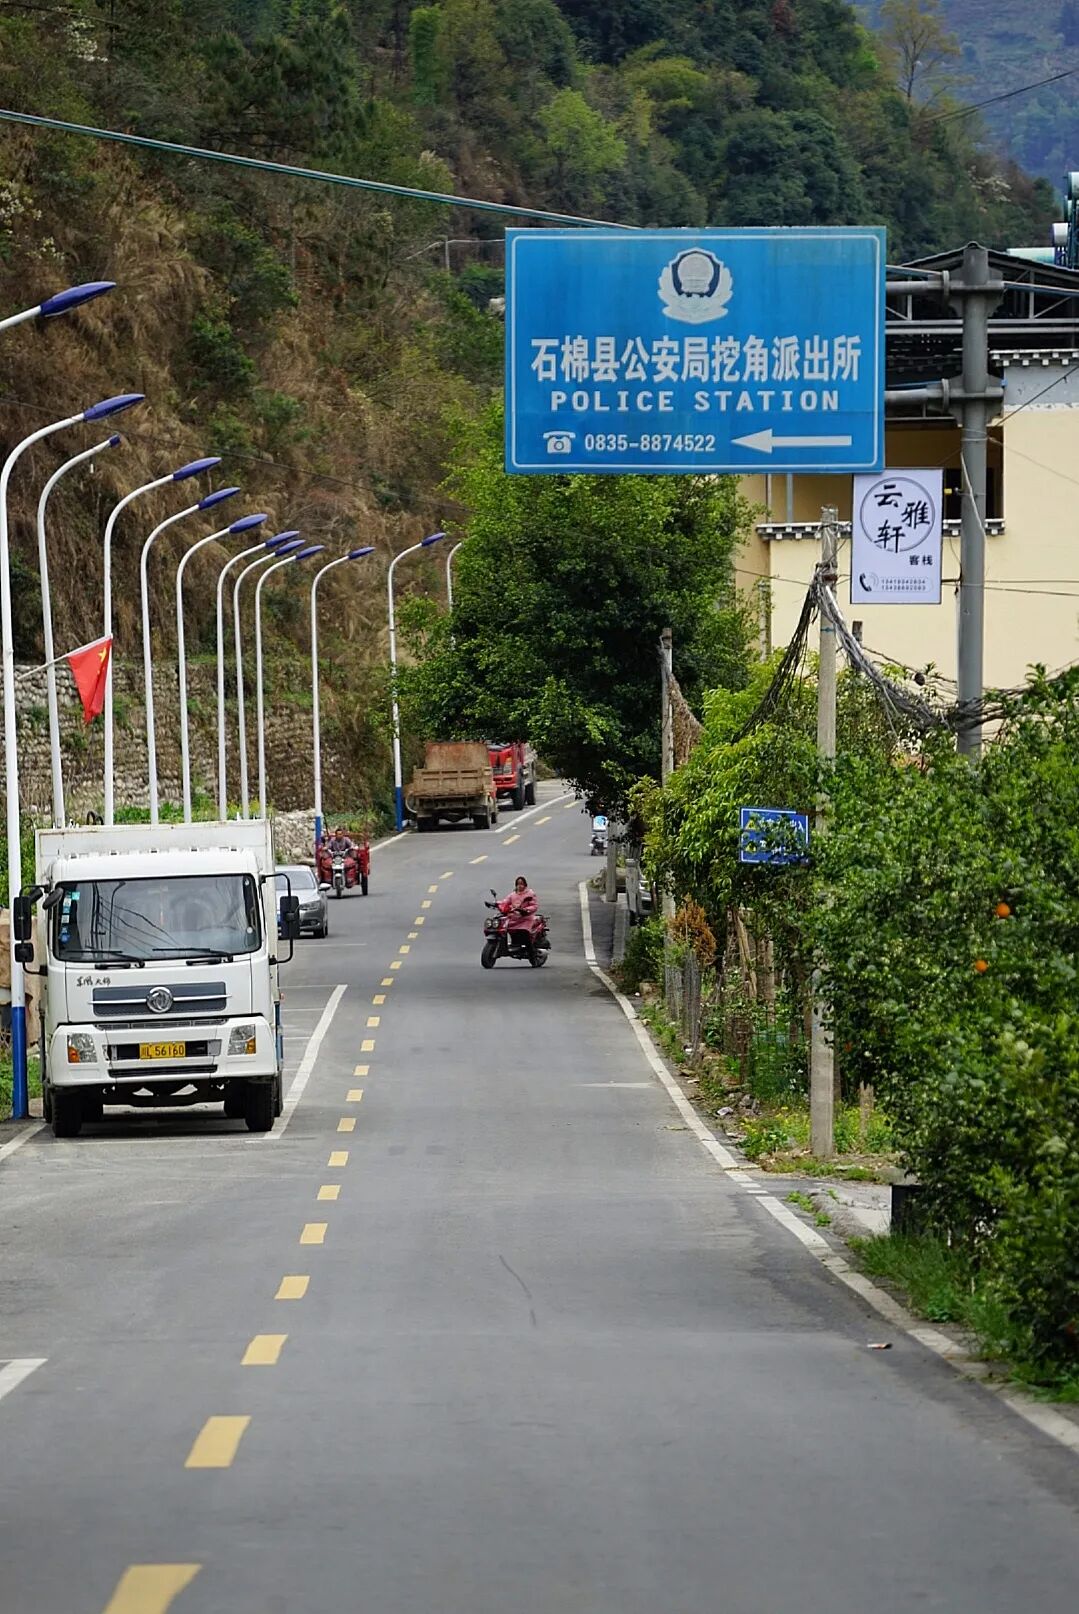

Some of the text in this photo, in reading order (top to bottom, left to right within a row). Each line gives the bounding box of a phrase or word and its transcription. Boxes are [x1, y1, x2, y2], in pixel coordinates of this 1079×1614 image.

[531, 335, 861, 383] 石棉县公安局挖角派出所
[550, 390, 840, 412] POLICE STATION
[584, 433, 716, 453] 0835-8874522
